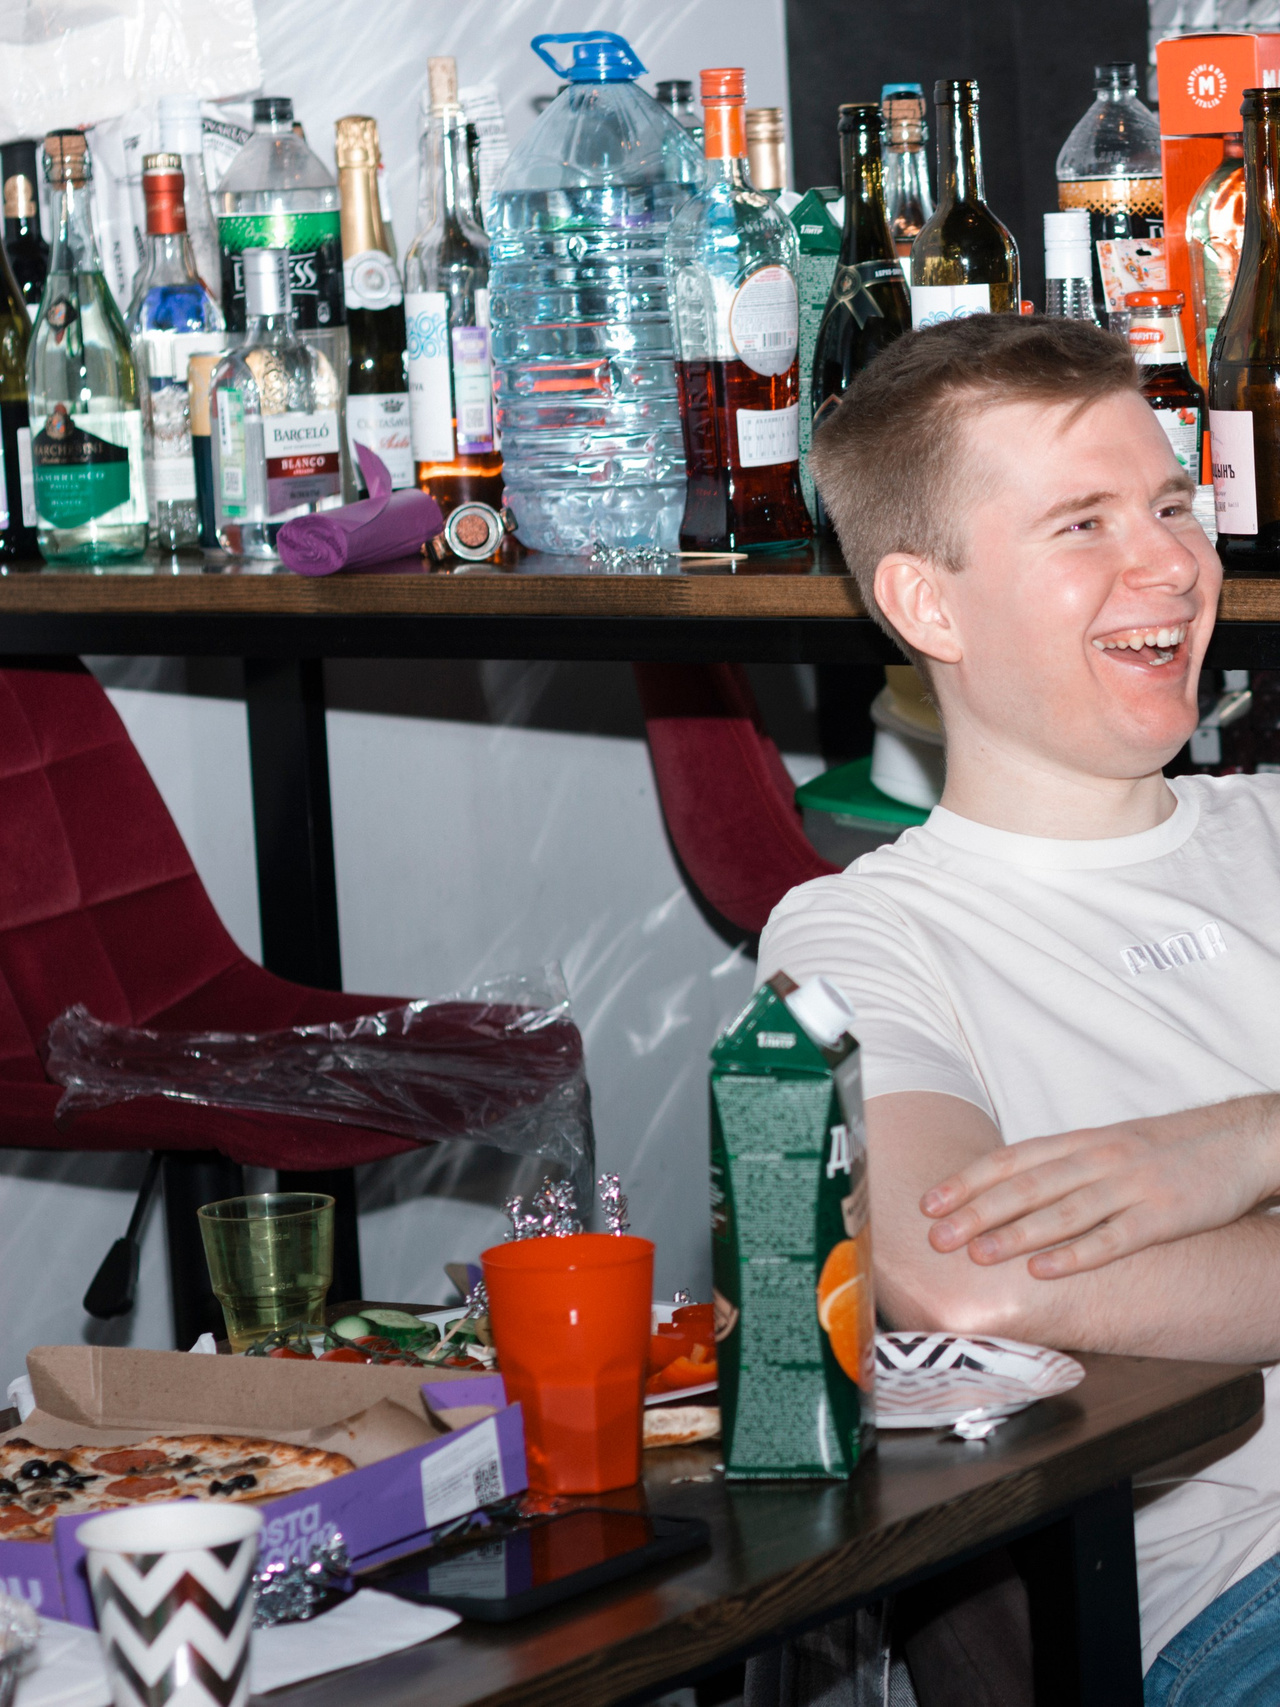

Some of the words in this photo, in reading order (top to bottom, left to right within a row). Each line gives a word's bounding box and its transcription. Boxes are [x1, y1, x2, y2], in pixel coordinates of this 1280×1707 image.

[1195, 98, 1220, 108] ITALIA
[274, 422, 329, 442] BARCELÓ
[281, 455, 326, 471] BLANCO
[1120, 921, 1228, 976] PUMA
